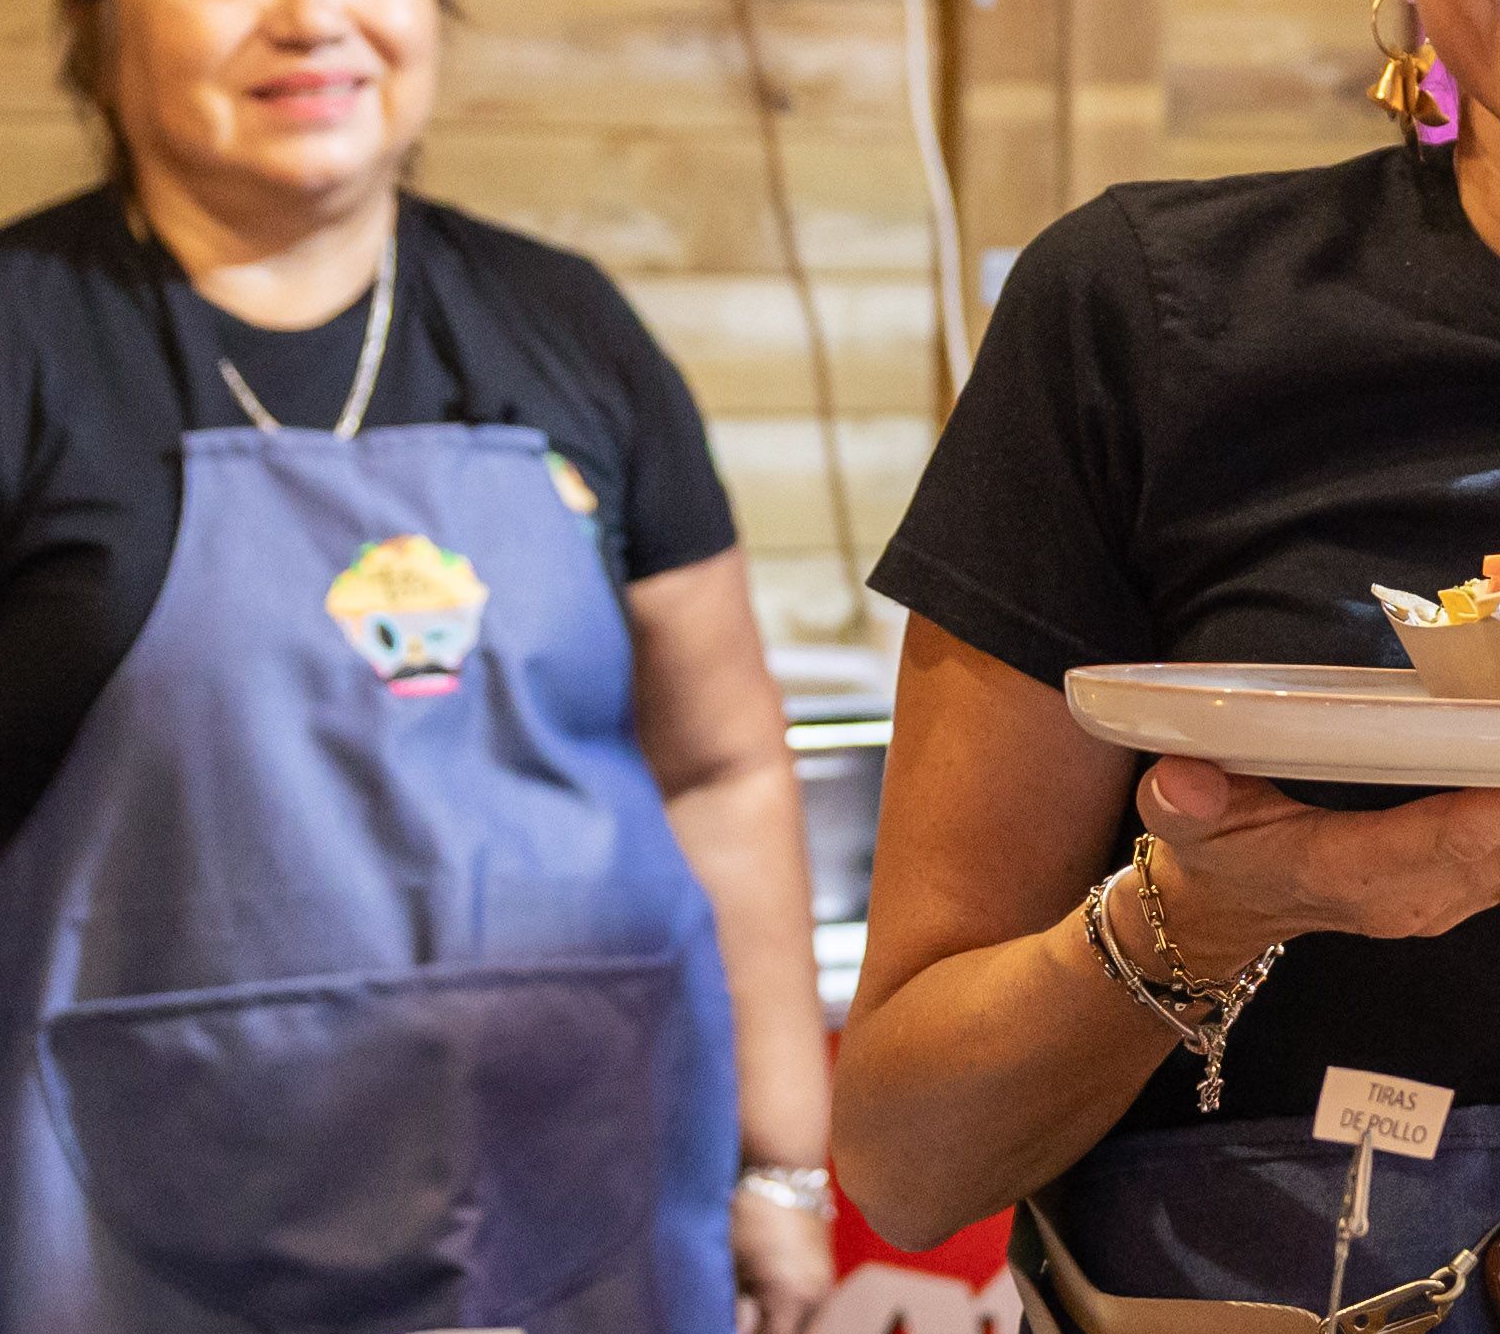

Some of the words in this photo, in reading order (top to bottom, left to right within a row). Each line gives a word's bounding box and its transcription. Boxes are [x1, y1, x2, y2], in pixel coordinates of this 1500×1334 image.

[1367, 1082, 1418, 1110] TIRAS
[1340, 1107, 1364, 1132] DE
[1366, 1113, 1428, 1144] POLLO
